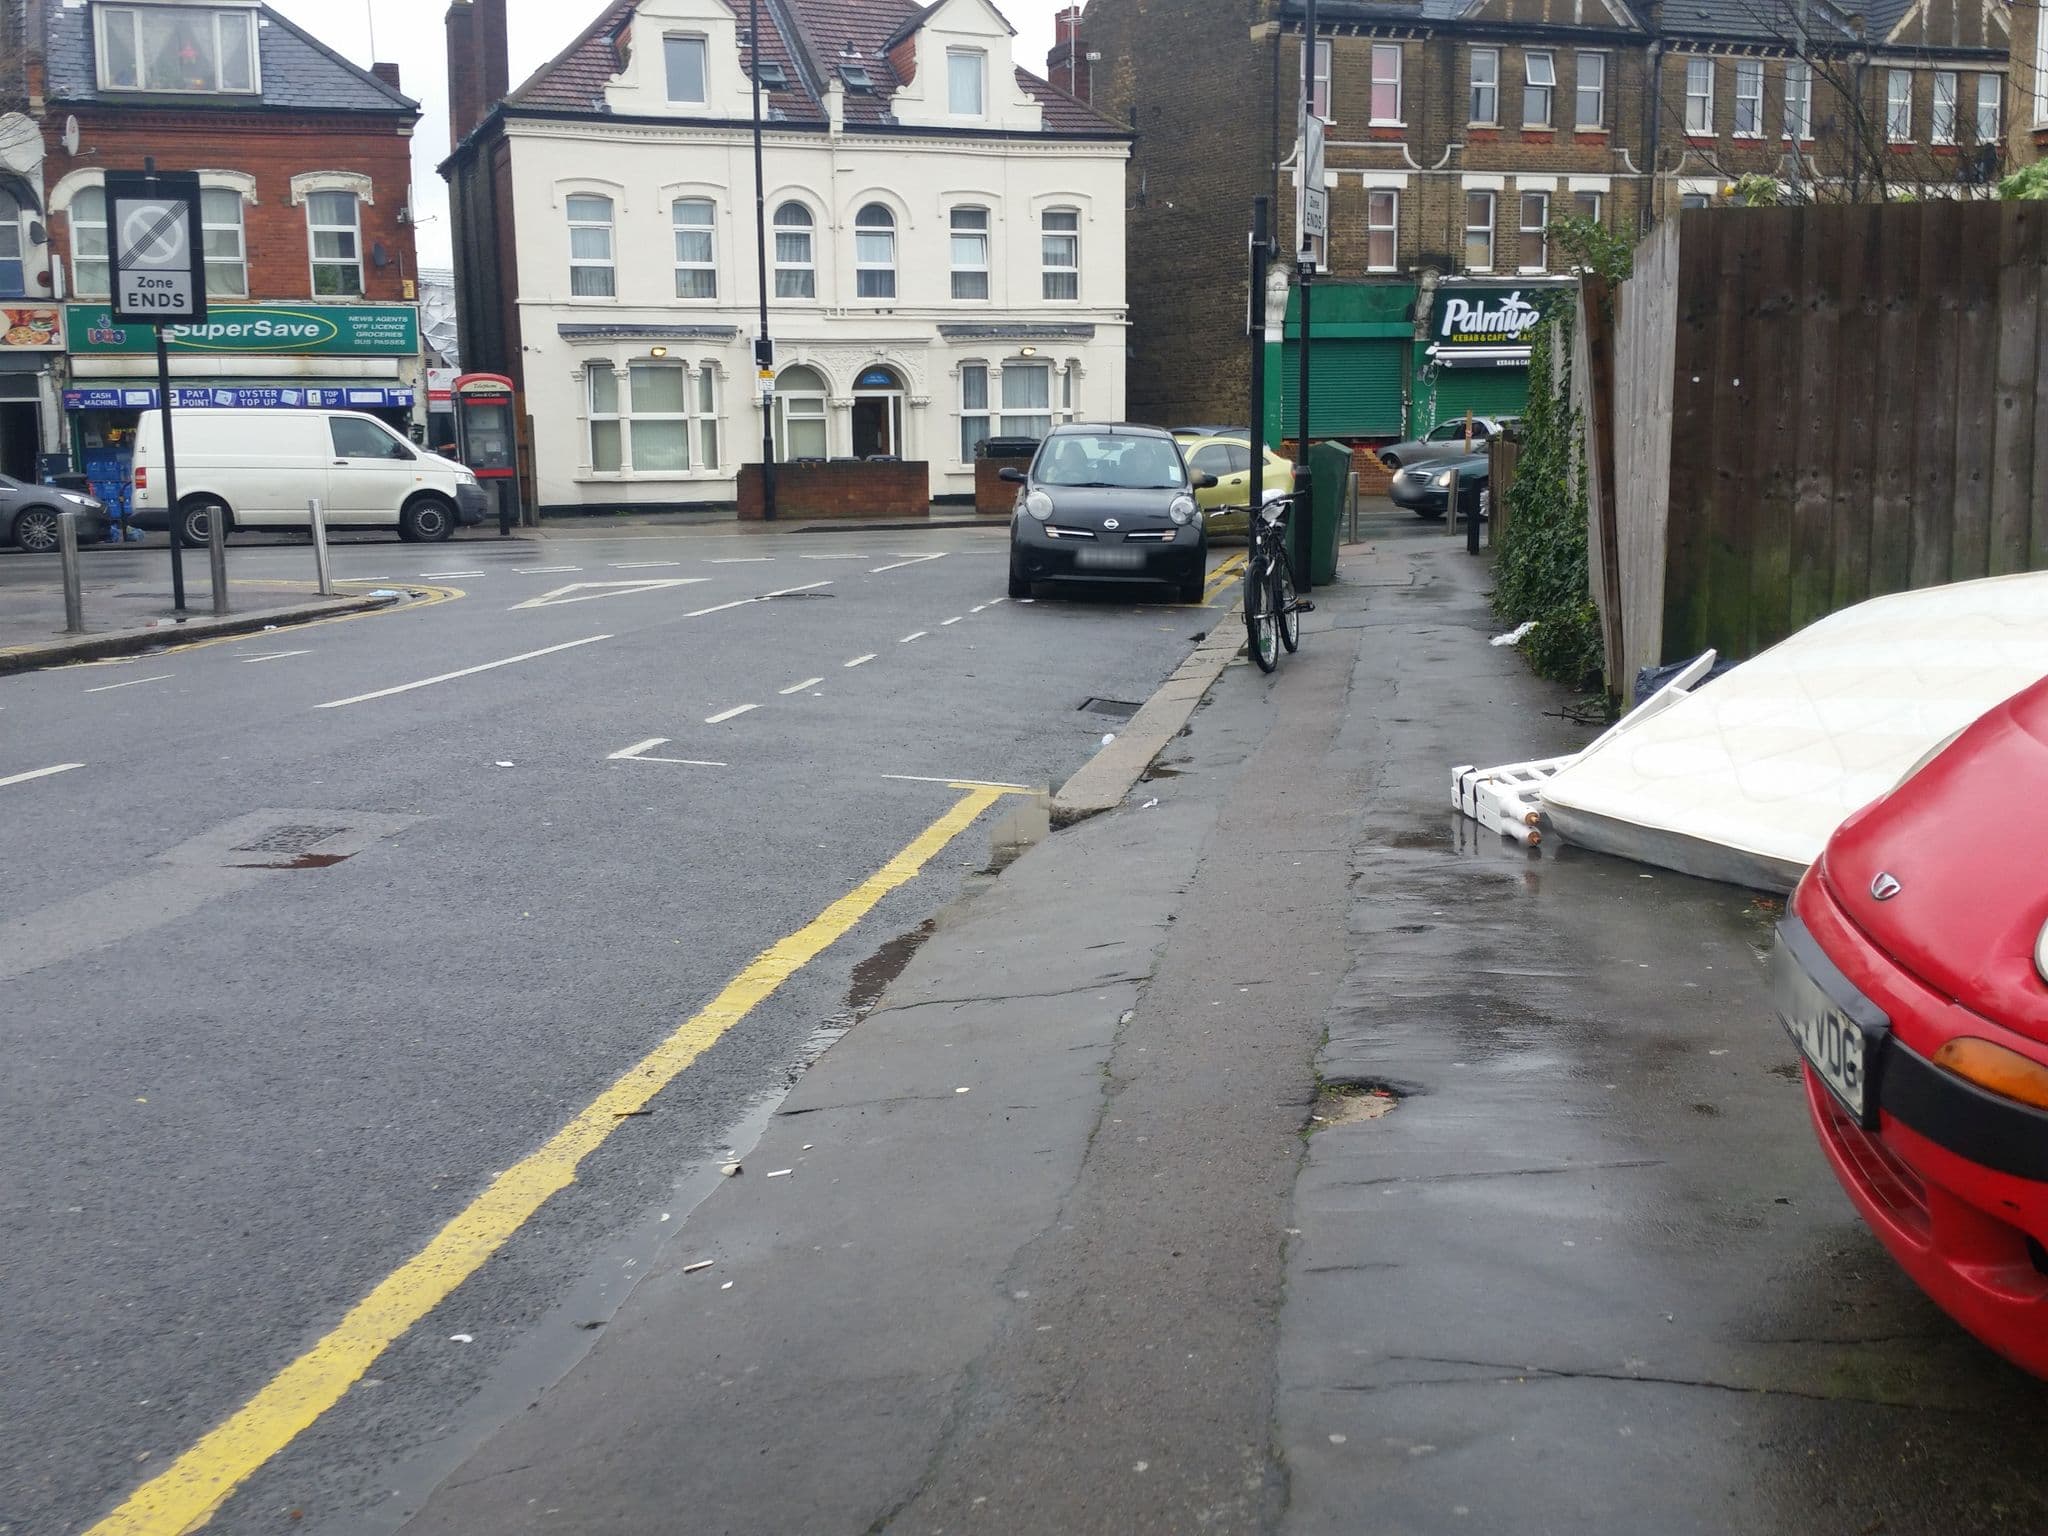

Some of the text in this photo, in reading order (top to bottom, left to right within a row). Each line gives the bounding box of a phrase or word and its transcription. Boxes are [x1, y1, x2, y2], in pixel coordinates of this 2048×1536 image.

[1307, 211, 1322, 230] ENDS
[137, 276, 174, 289] Zone
[128, 293, 185, 308] ENDS
[1441, 296, 1540, 339] Palmiye
[173, 319, 319, 340] SuperSave
[1452, 333, 1479, 342] KEBAB
[186, 390, 204, 398] PAY
[239, 389, 278, 398] OYSTER
[84, 399, 119, 407] MACHINE
[182, 399, 210, 407] POINT
[240, 398, 277, 406] TOP UP
